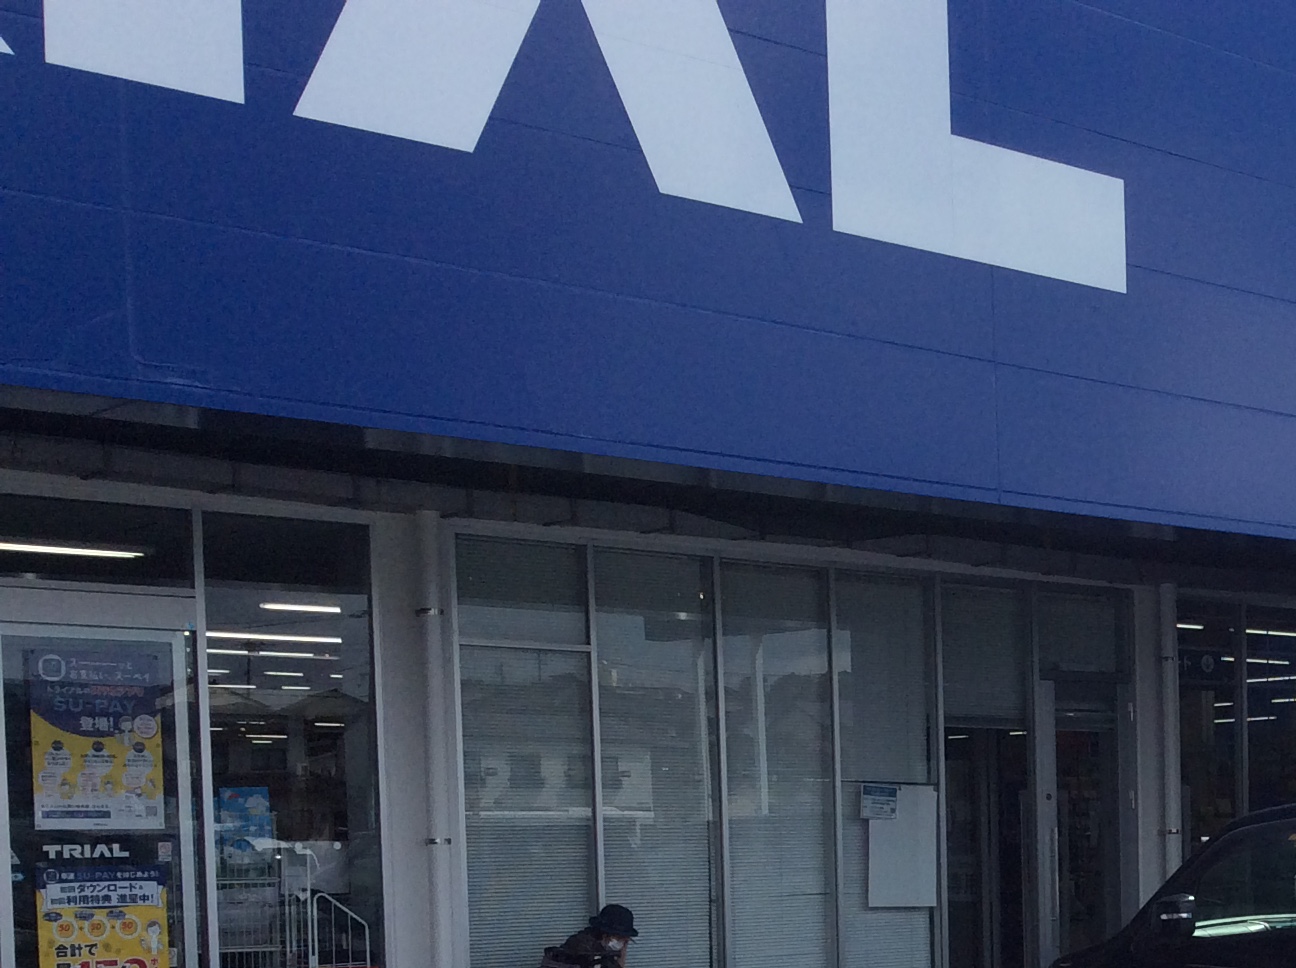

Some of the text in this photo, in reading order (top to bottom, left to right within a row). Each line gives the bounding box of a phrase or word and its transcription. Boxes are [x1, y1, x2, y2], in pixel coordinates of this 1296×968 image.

[53, 696, 135, 713] SU-PAY
[42, 843, 130, 859] TRIAL
[54, 943, 98, 958] 合計で
